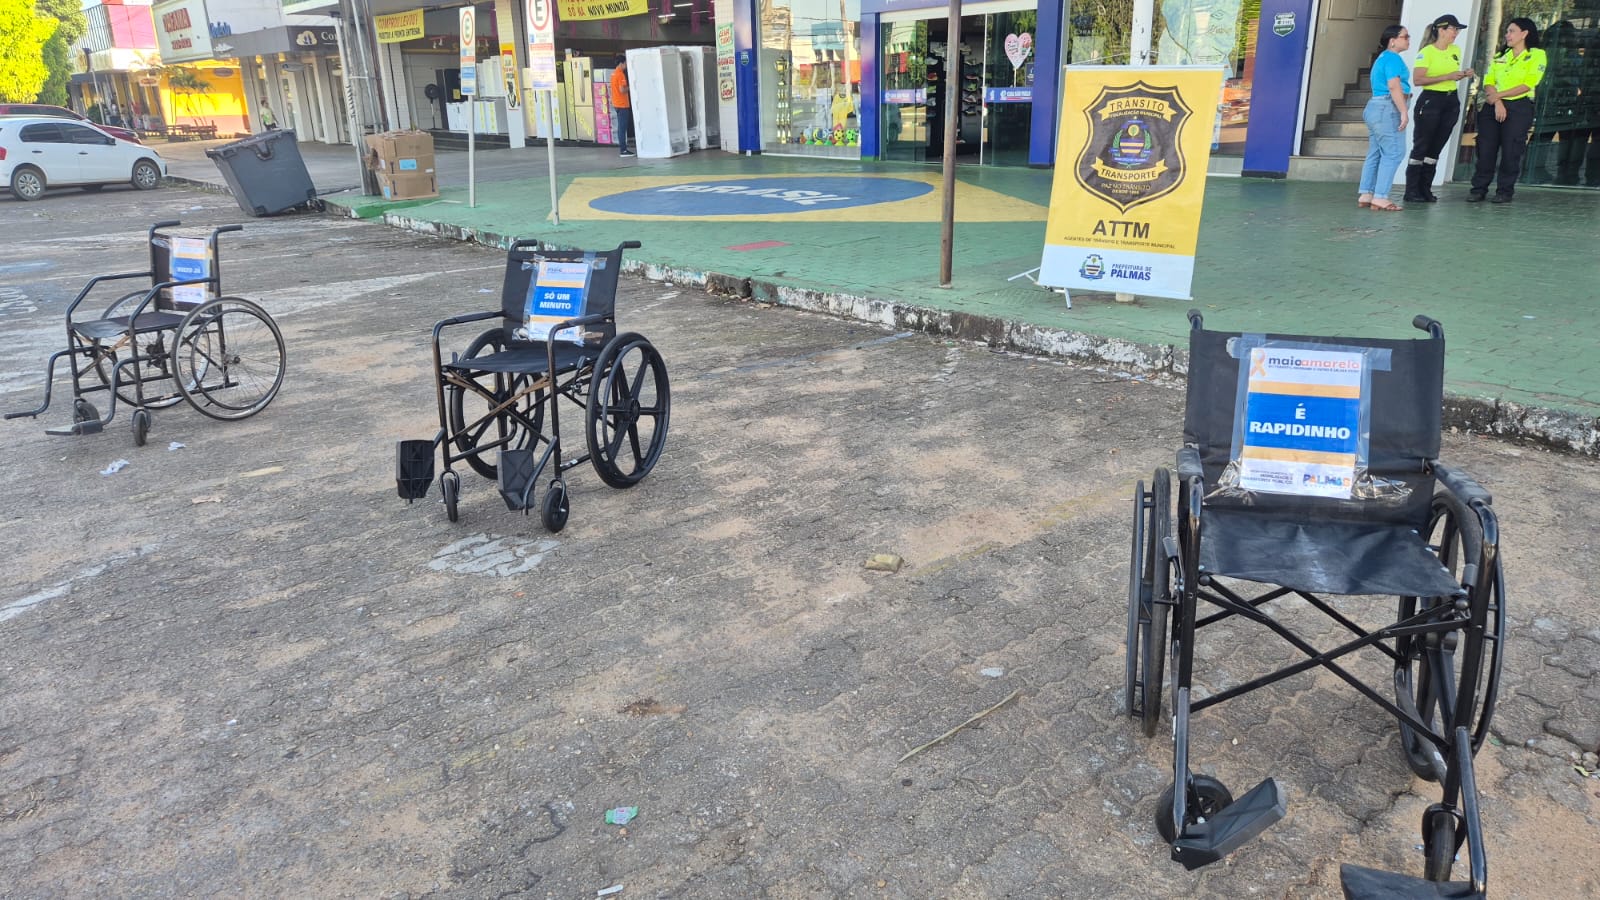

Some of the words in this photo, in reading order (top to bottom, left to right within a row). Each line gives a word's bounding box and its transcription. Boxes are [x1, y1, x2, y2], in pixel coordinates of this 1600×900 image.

[588, 5, 605, 16] NOVO
[606, 1, 629, 14] MUNDO
[1101, 169, 1157, 180] TRANSPORTE
[1092, 219, 1150, 239] ATTM
[1110, 269, 1151, 281] PALMAS
[544, 291, 555, 300] SÓ
[539, 301, 571, 309] MINUTO
[1295, 403, 1306, 420] É
[1249, 421, 1351, 440] RAPIDINHO
[1303, 473, 1351, 487] PALMAS
